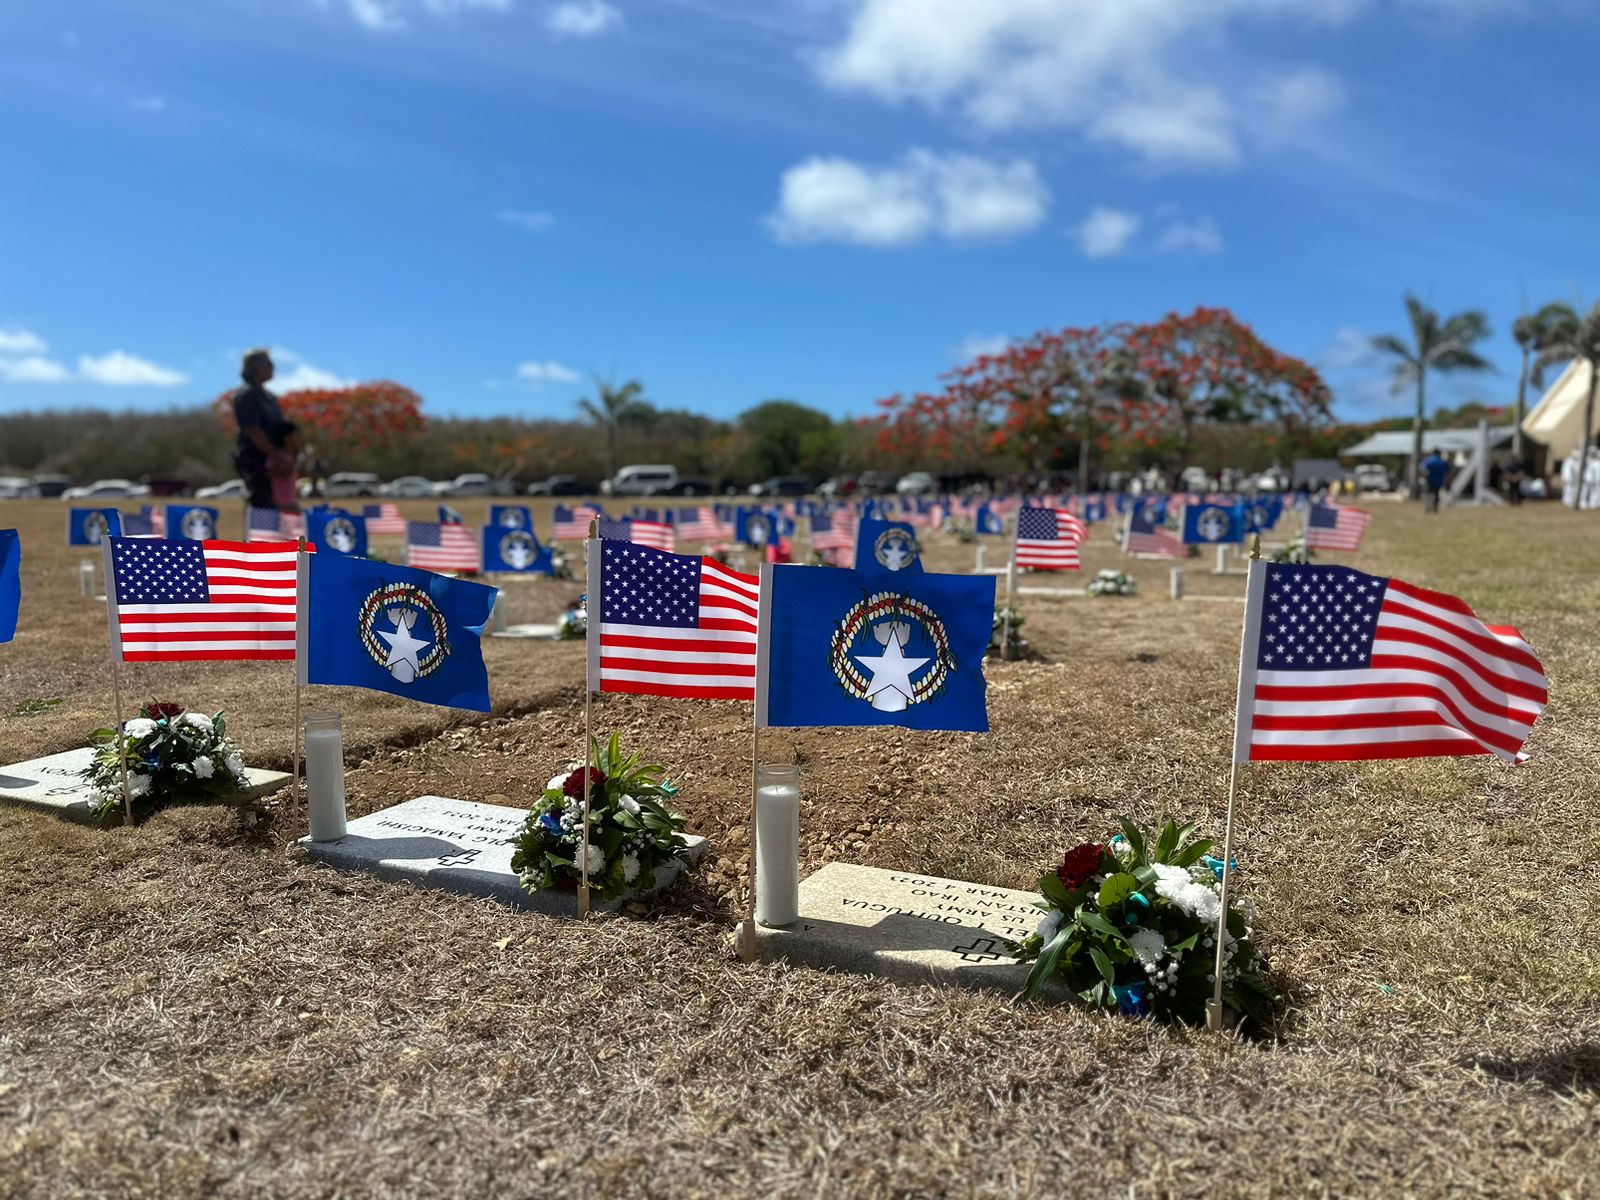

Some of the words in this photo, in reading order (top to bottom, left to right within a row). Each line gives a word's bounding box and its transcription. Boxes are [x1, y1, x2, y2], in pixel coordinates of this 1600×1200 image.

[376, 820, 467, 840] YAMAGISHI
[466, 824, 508, 834] ARMY
[965, 886, 1009, 899] MAR
[932, 904, 991, 917] ARMY
[1001, 915, 1025, 923] US
